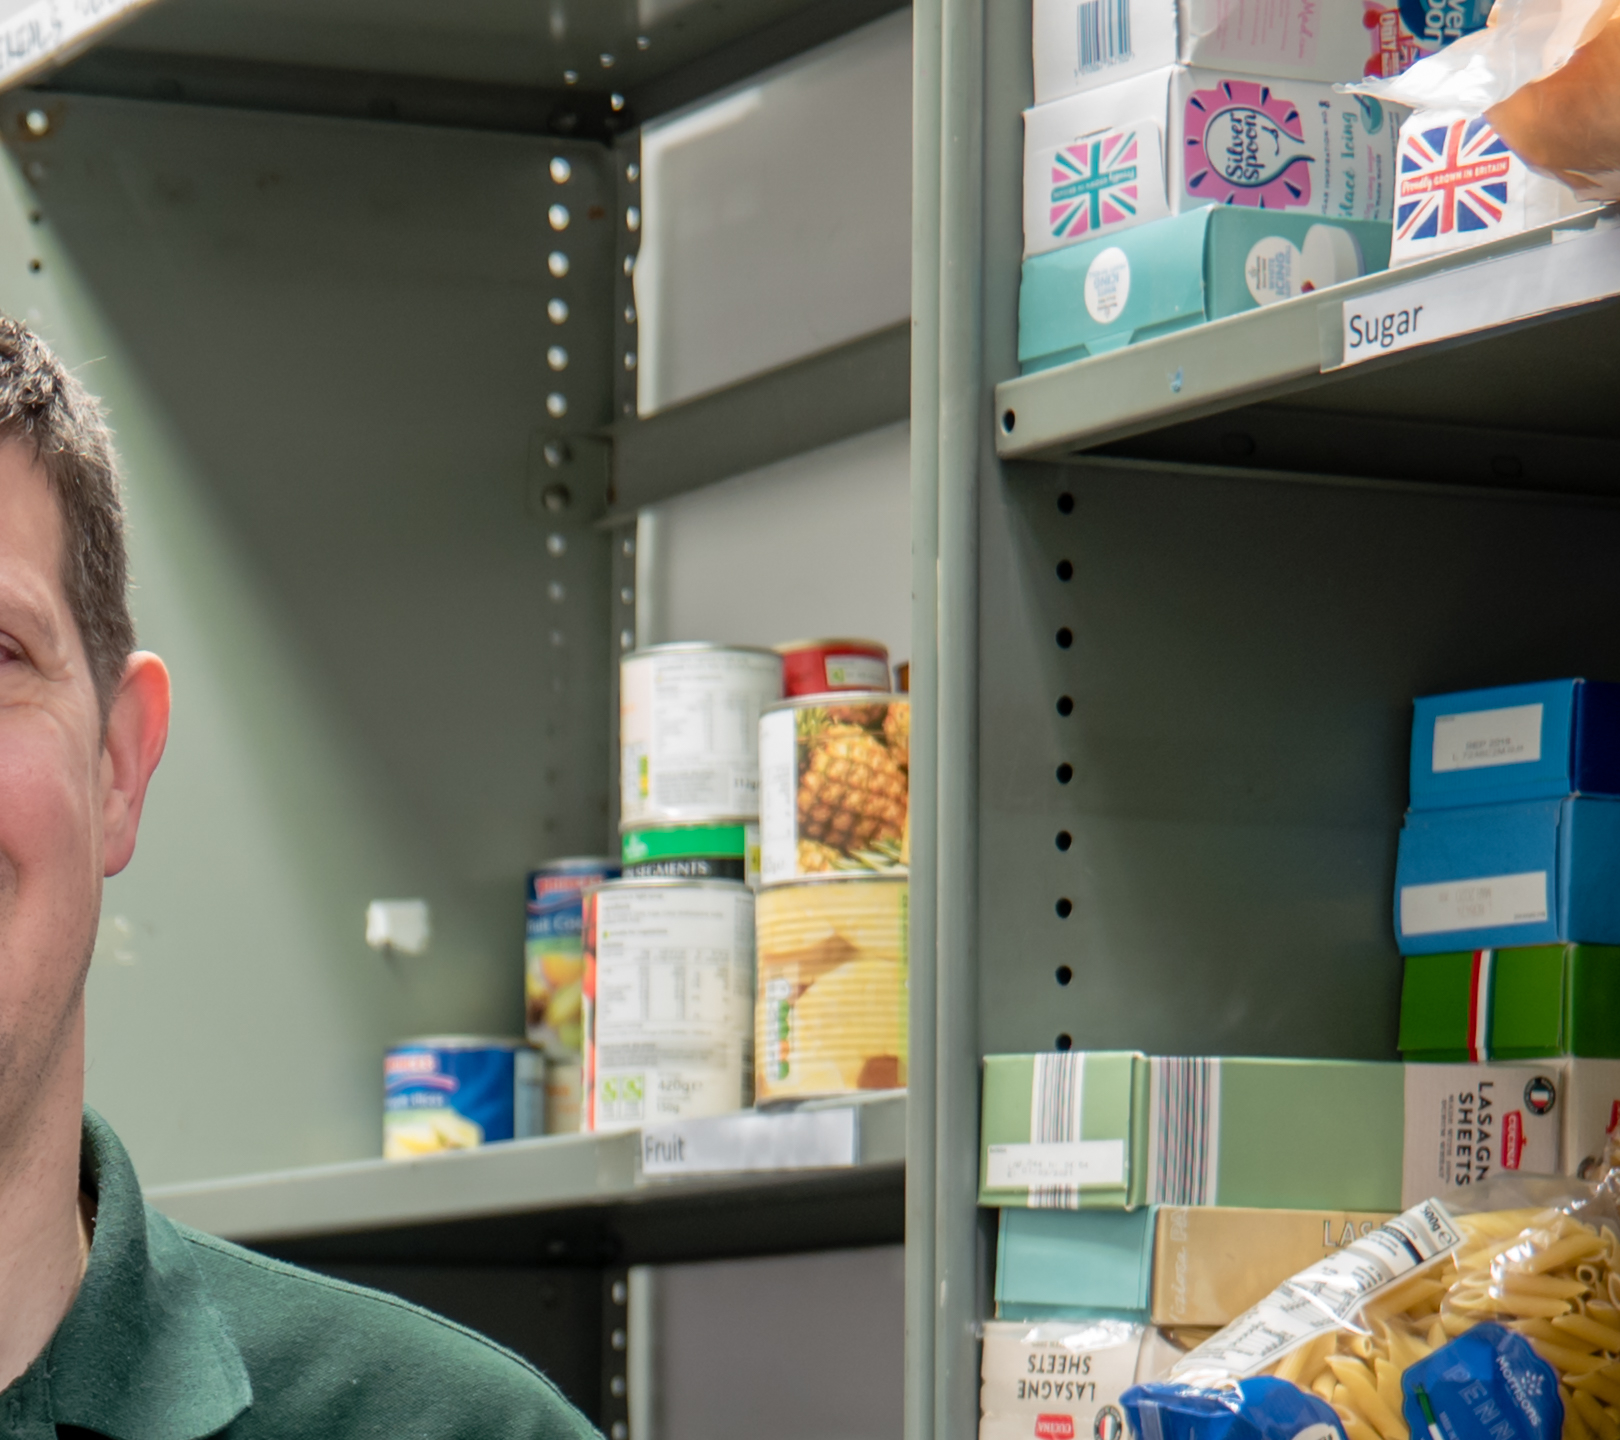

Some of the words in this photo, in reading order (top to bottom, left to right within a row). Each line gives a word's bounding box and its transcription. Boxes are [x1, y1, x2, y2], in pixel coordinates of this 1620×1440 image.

[1225, 112, 1244, 179] Silver
[1244, 114, 1266, 181] Spoon
[1401, 178, 1432, 195] Proudly
[1474, 161, 1507, 180] BRITAIN
[1348, 303, 1424, 350] Sugar
[644, 1134, 685, 1163] Fruit
[1456, 1092, 1474, 1187] SHEETS
[1027, 1354, 1092, 1374] SHEETS
[1016, 1378, 1096, 1402] LASAGNE
[1496, 1355, 1541, 1428] Morrisons
